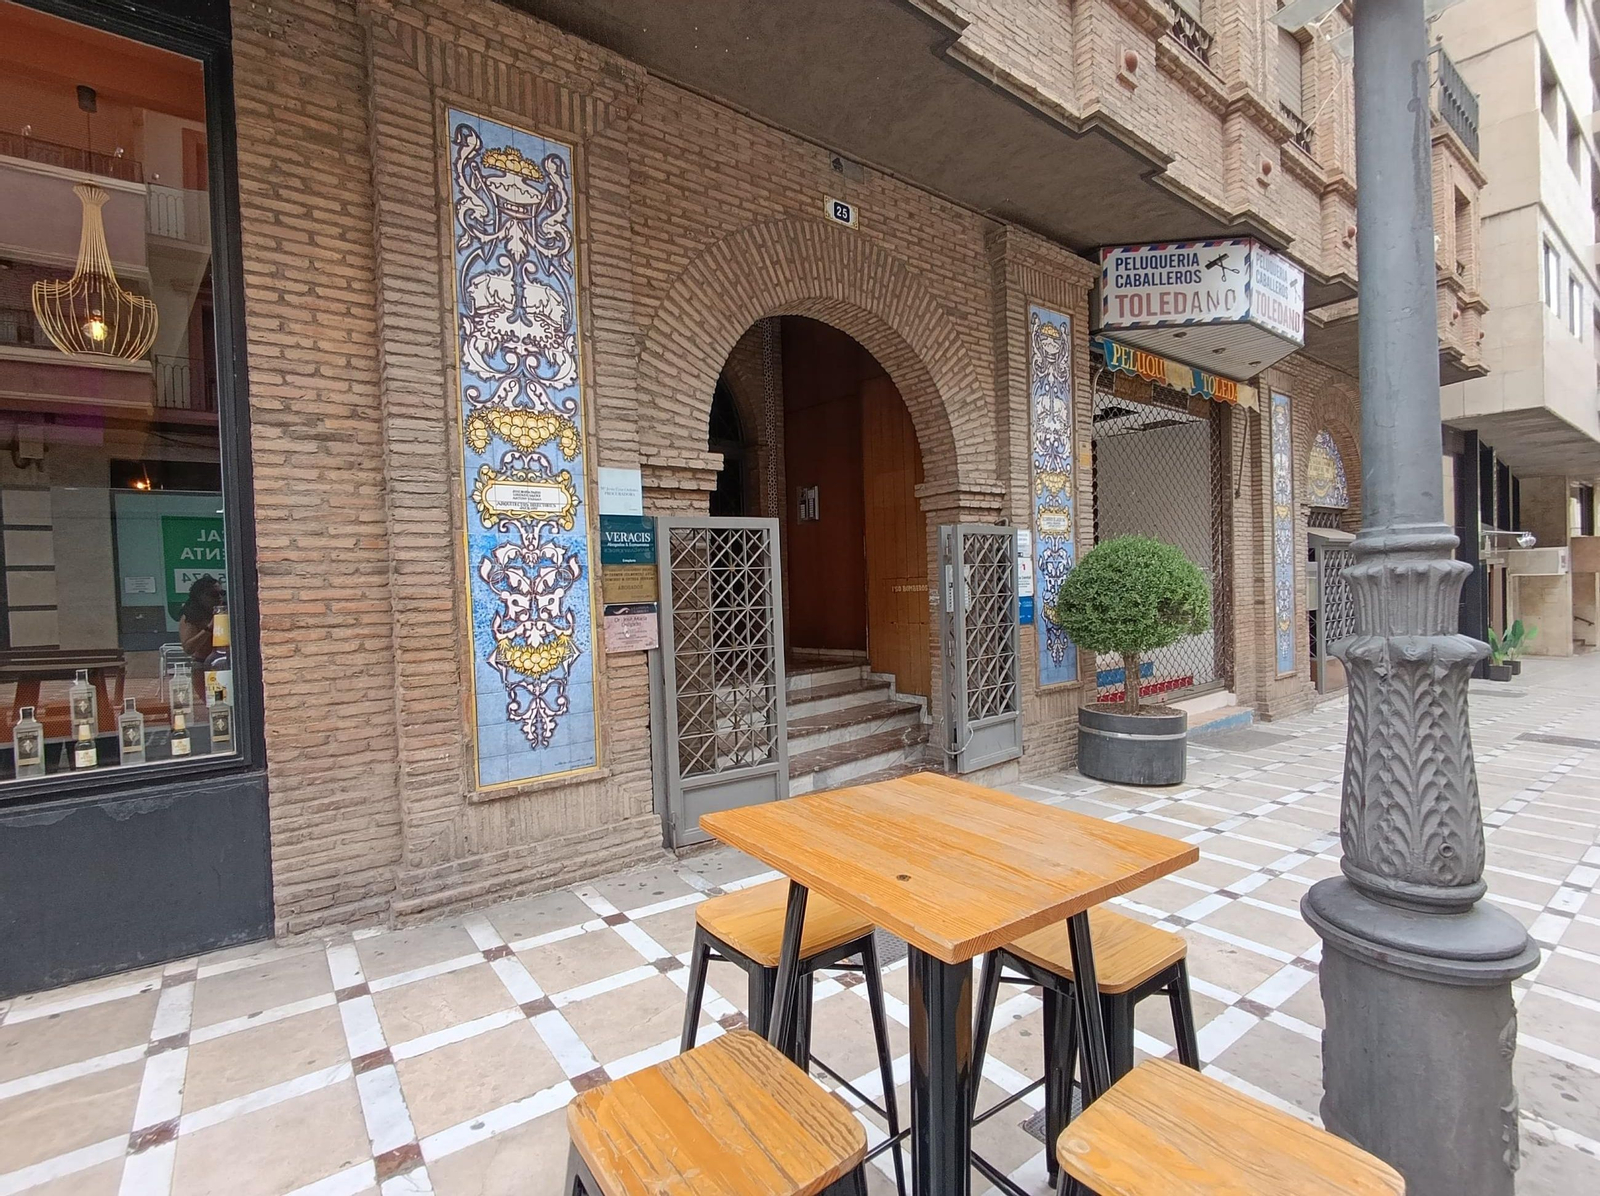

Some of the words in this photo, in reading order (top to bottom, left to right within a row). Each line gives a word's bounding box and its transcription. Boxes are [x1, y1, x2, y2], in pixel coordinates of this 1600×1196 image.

[836, 206, 848, 219] 25
[1115, 252, 1200, 272] PELUQUERIA
[1255, 252, 1289, 283] PELUQUERIA
[1115, 270, 1202, 289] CABALLEROS
[1255, 269, 1289, 300] CABALLEROS
[1115, 289, 1236, 319] TOLEDANO
[1255, 290, 1301, 333] TOLEDANO
[605, 531, 651, 543] VERACIS
